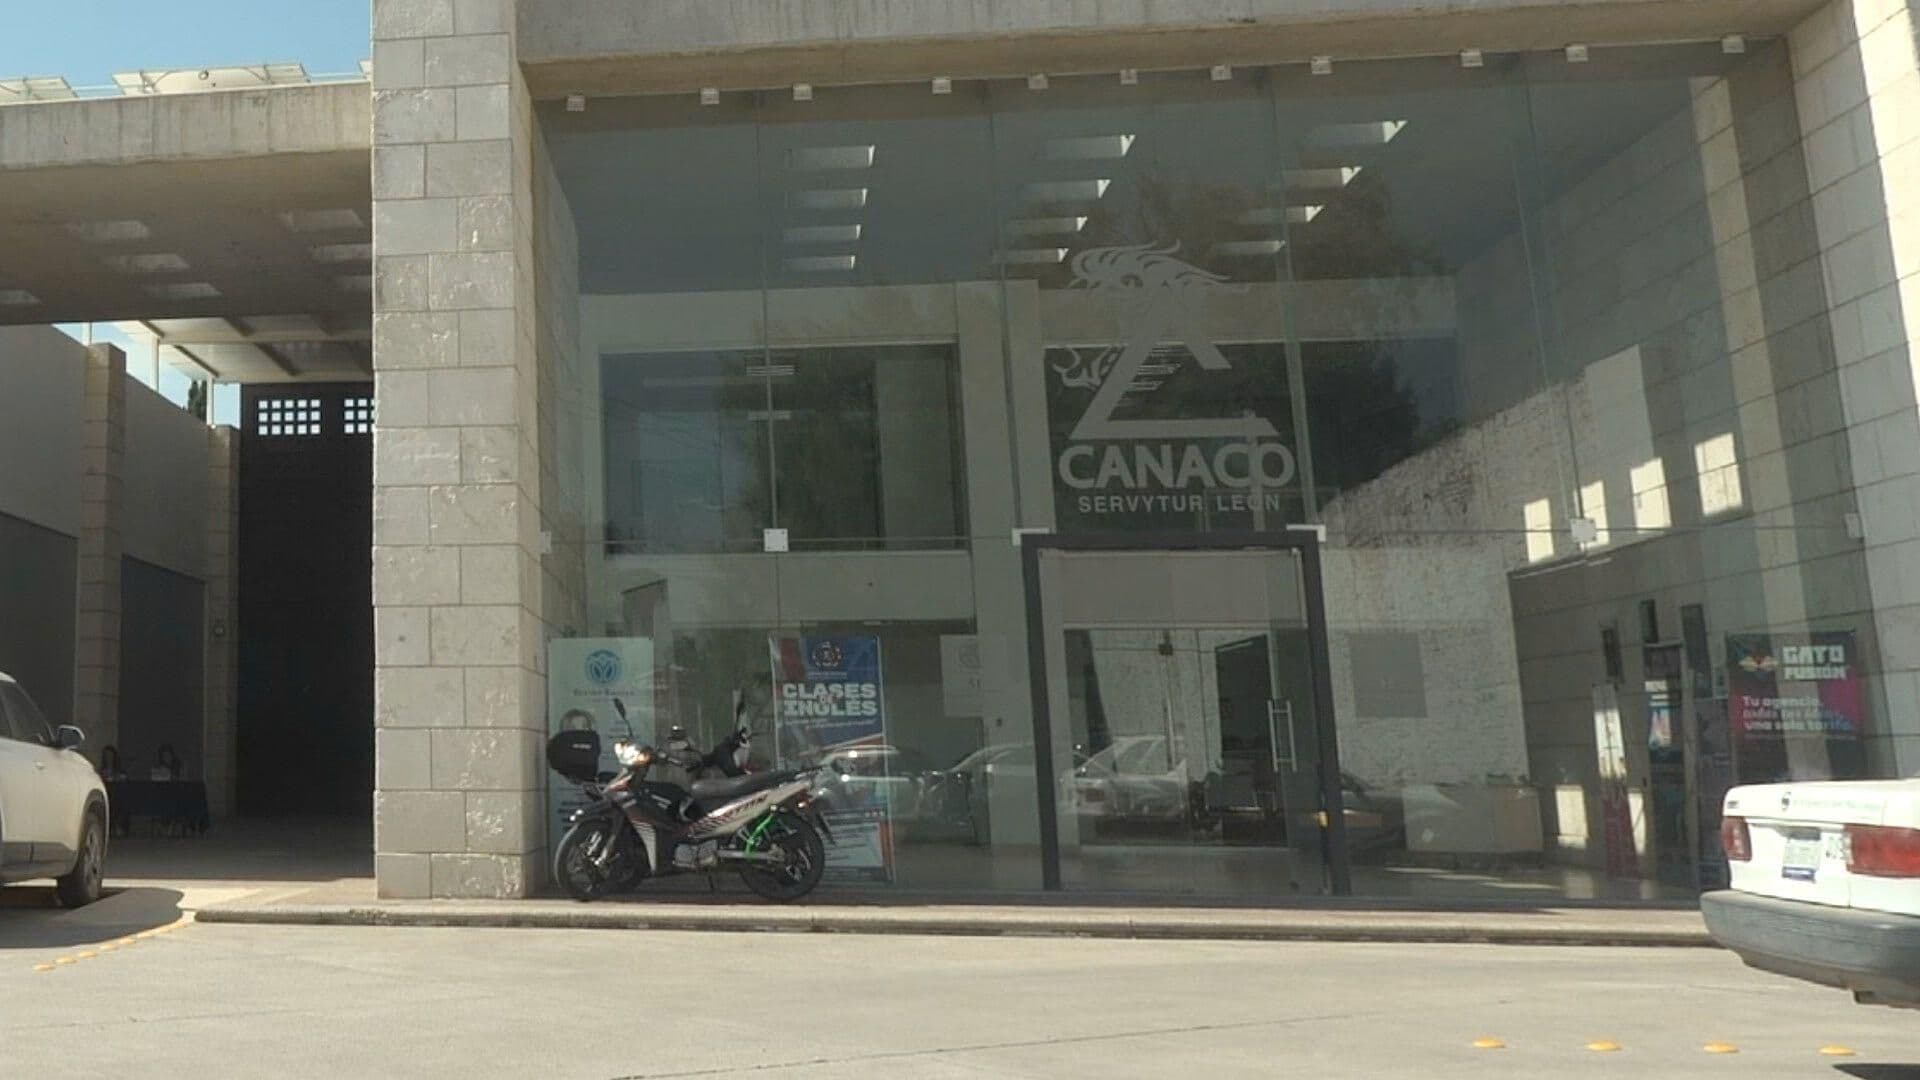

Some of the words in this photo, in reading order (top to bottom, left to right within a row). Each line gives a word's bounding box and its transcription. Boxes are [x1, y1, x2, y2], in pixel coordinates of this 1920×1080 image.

[1058, 443, 1296, 489] CANACO
[1077, 495, 1204, 513] SERVYTUR
[1782, 645, 1846, 664] GATO
[782, 682, 877, 699] CLASES
[1743, 696, 1760, 706] Tu
